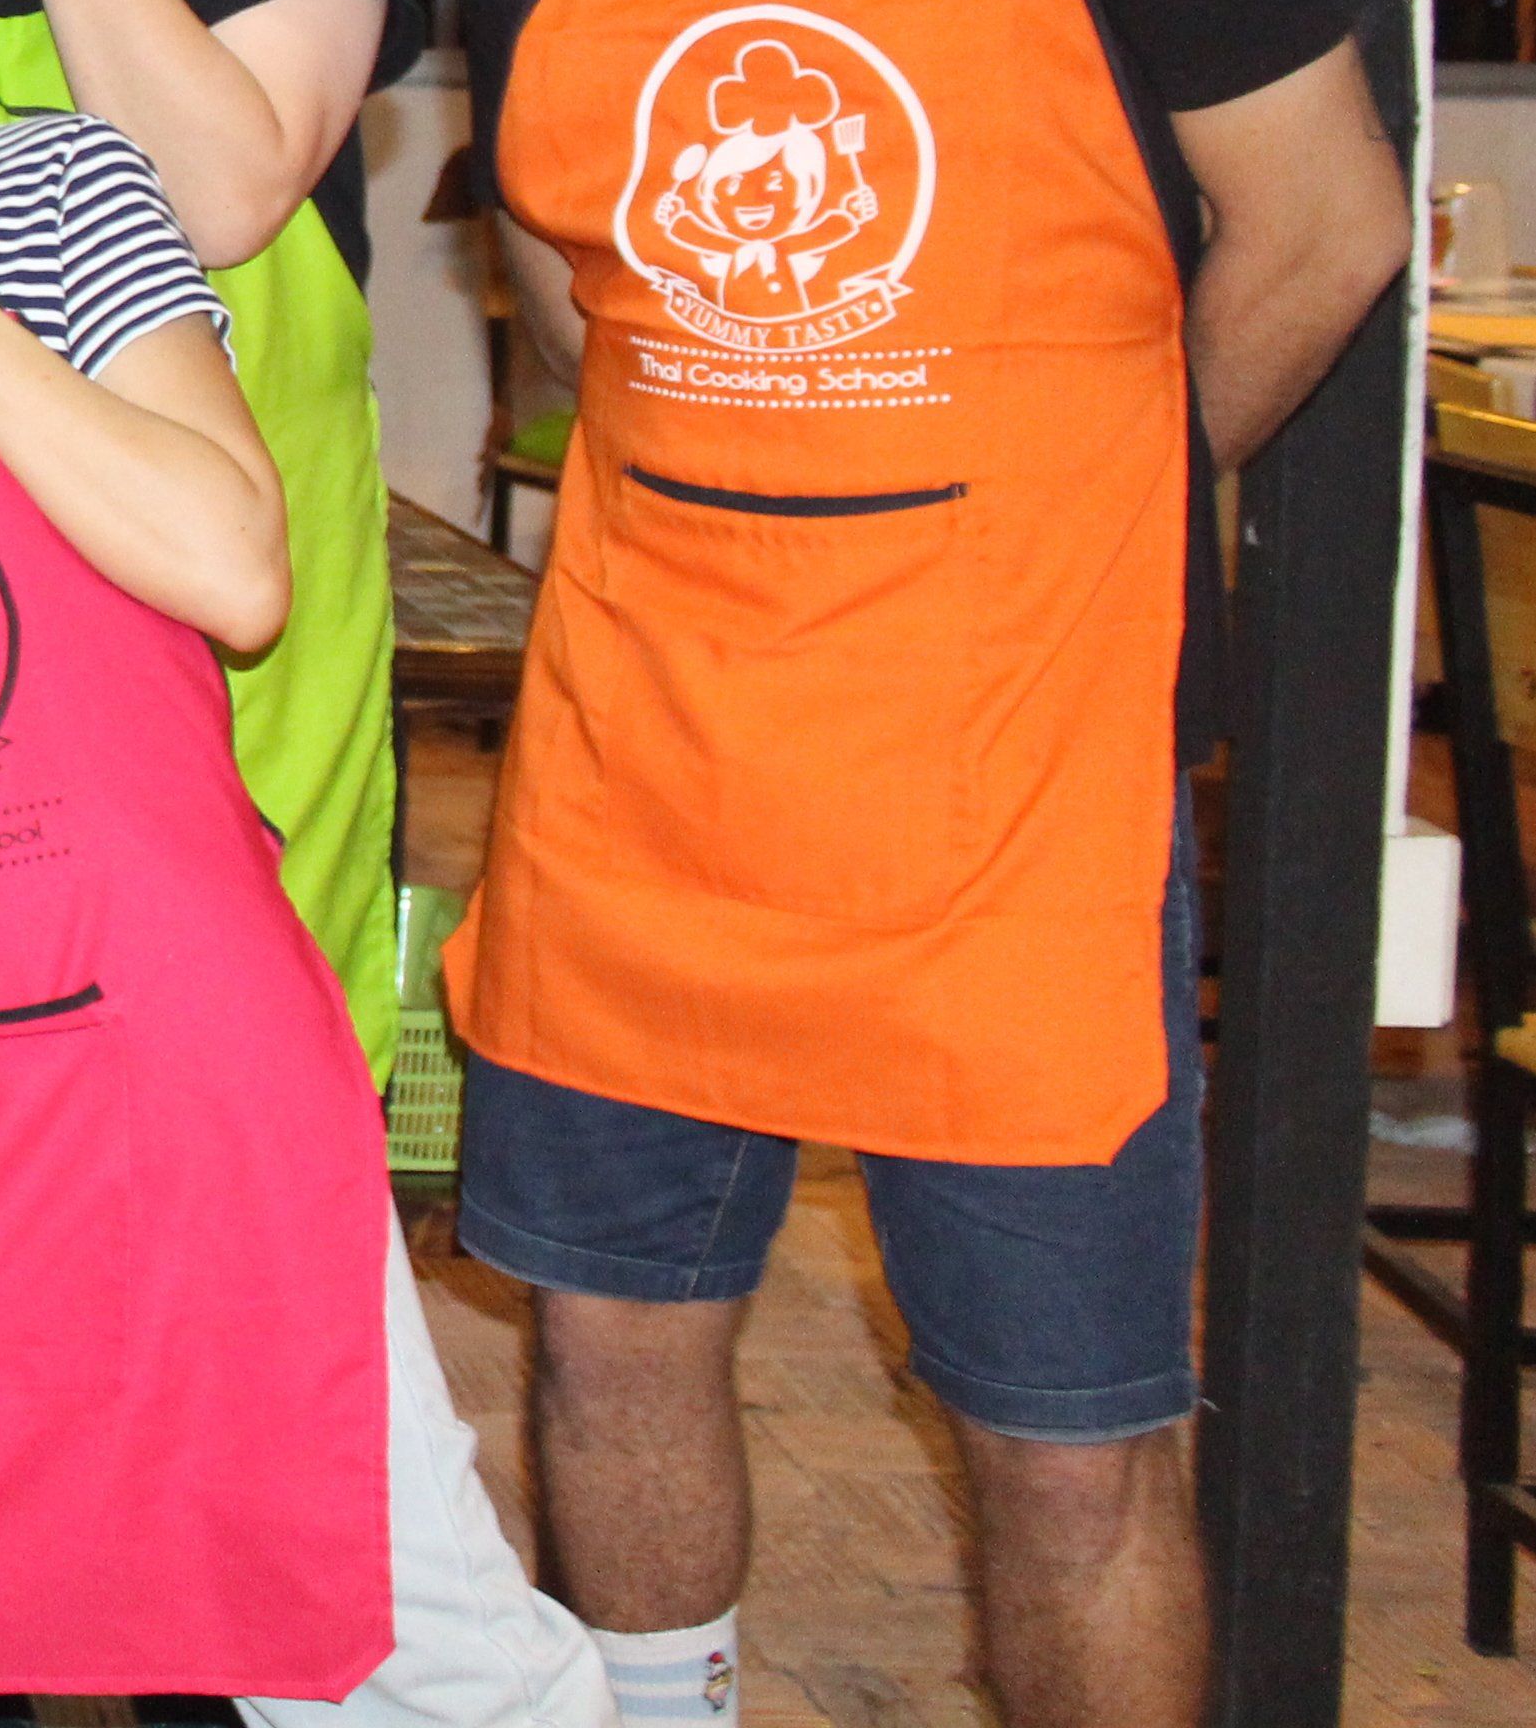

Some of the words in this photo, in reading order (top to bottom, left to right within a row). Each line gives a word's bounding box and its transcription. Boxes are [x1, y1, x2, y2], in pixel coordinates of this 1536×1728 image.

[682, 298, 771, 347] YUMMY
[783, 301, 870, 347] TASTY
[640, 352, 682, 382] Thai
[688, 364, 807, 395] Cooking
[818, 364, 928, 391] School
